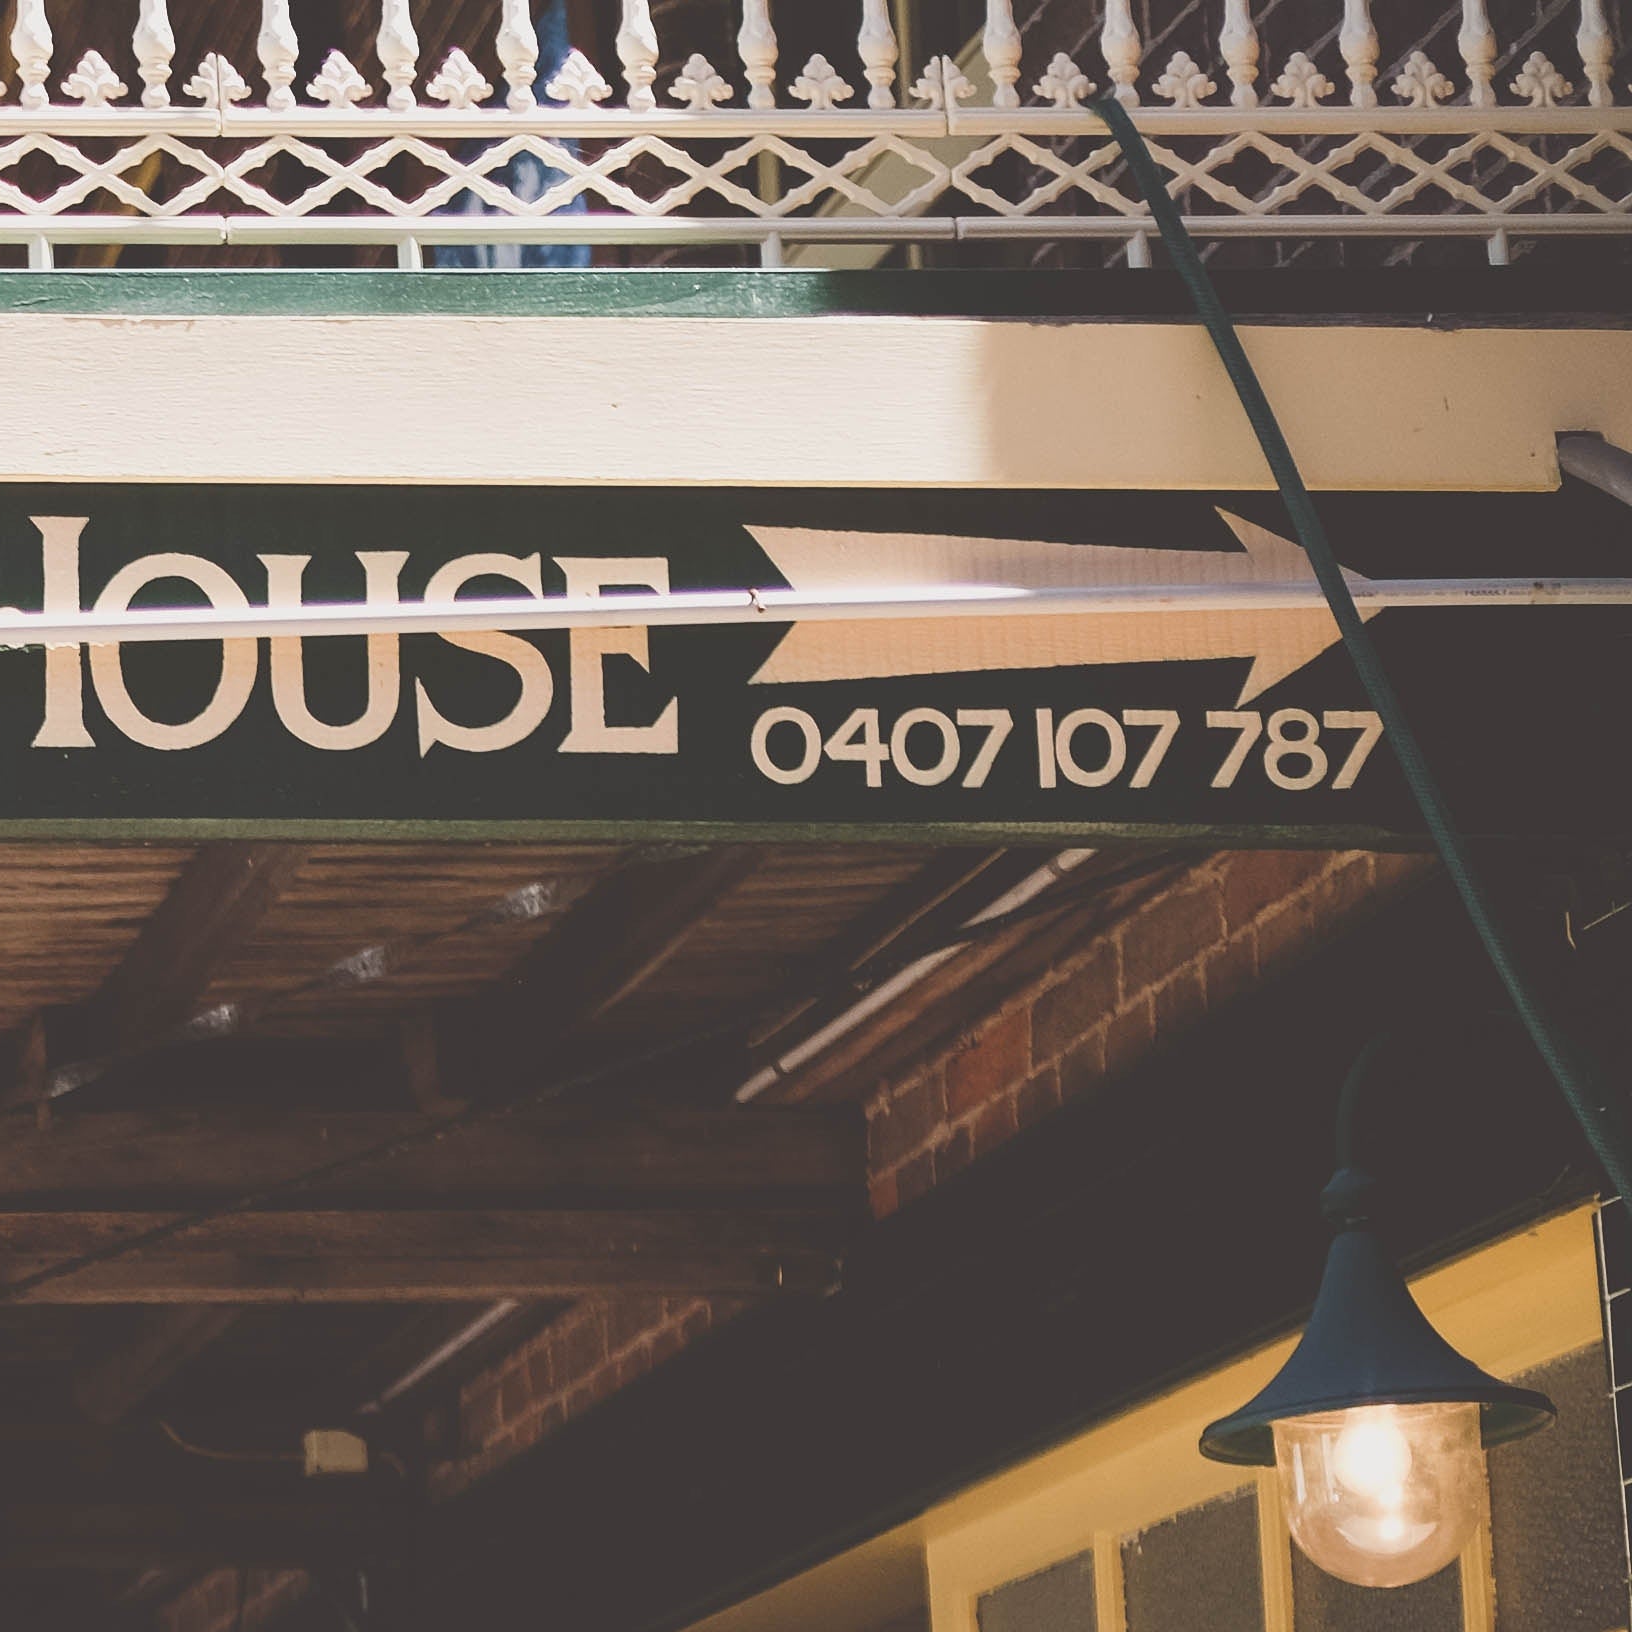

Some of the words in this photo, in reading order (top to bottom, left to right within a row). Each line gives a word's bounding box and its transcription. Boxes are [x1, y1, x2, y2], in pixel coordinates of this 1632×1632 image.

[750, 706, 1013, 788] 0407
[1036, 706, 1180, 788] 107
[1205, 710, 1384, 790] 787
